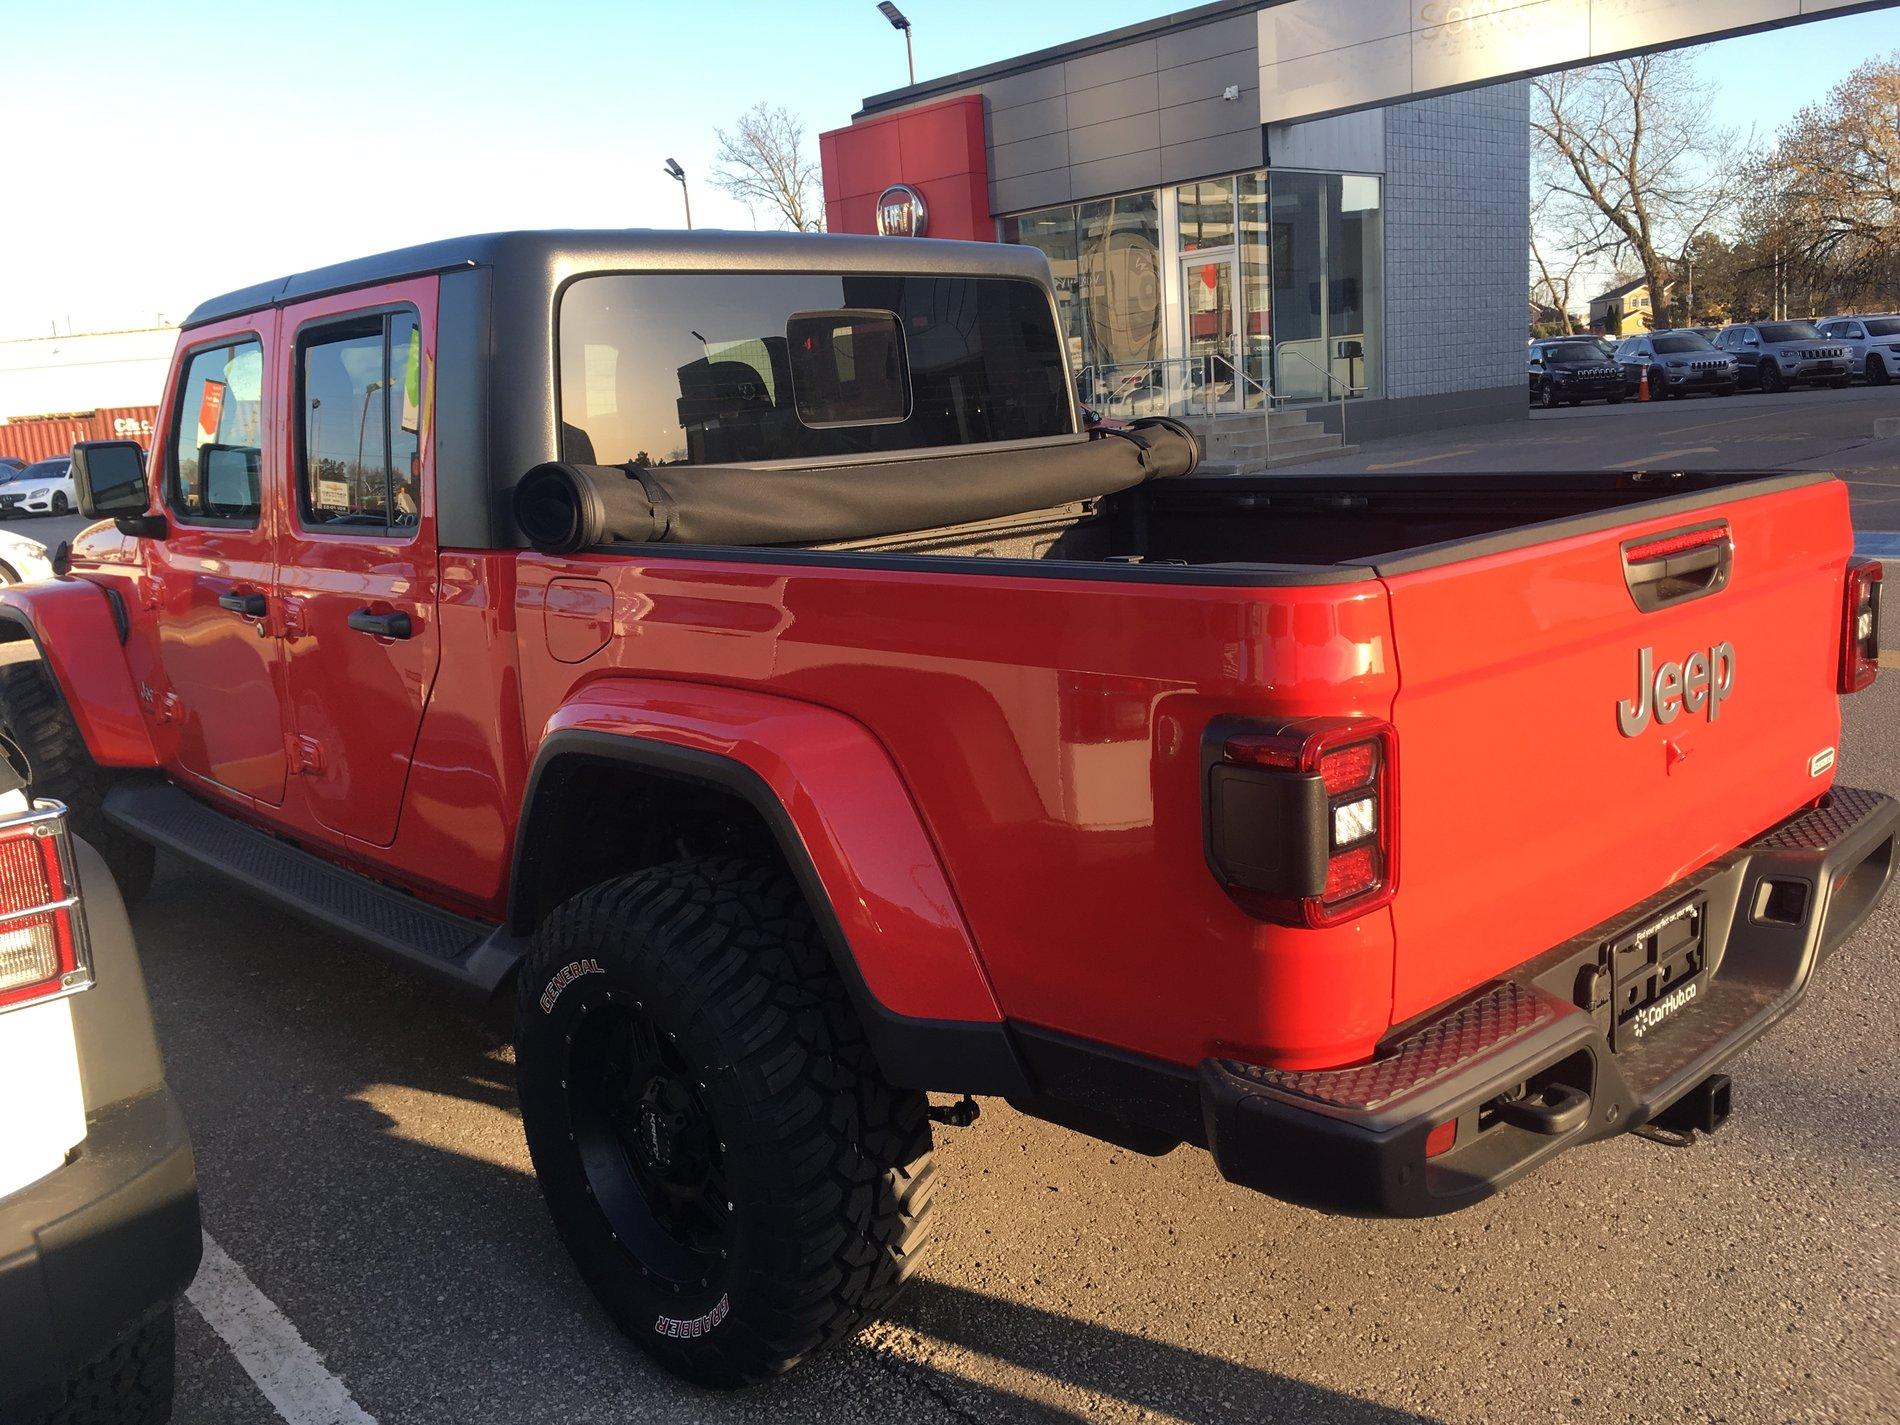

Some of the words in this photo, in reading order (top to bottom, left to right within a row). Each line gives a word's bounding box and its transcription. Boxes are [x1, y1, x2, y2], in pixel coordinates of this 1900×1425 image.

[884, 202, 912, 234] FIAT
[1616, 640, 1736, 738] Jeep
[1655, 917, 1670, 932] perfect
[540, 958, 606, 1014] GENERAL
[1648, 983, 1697, 1027] CarHub.ca
[655, 1292, 730, 1338] GRABBER
